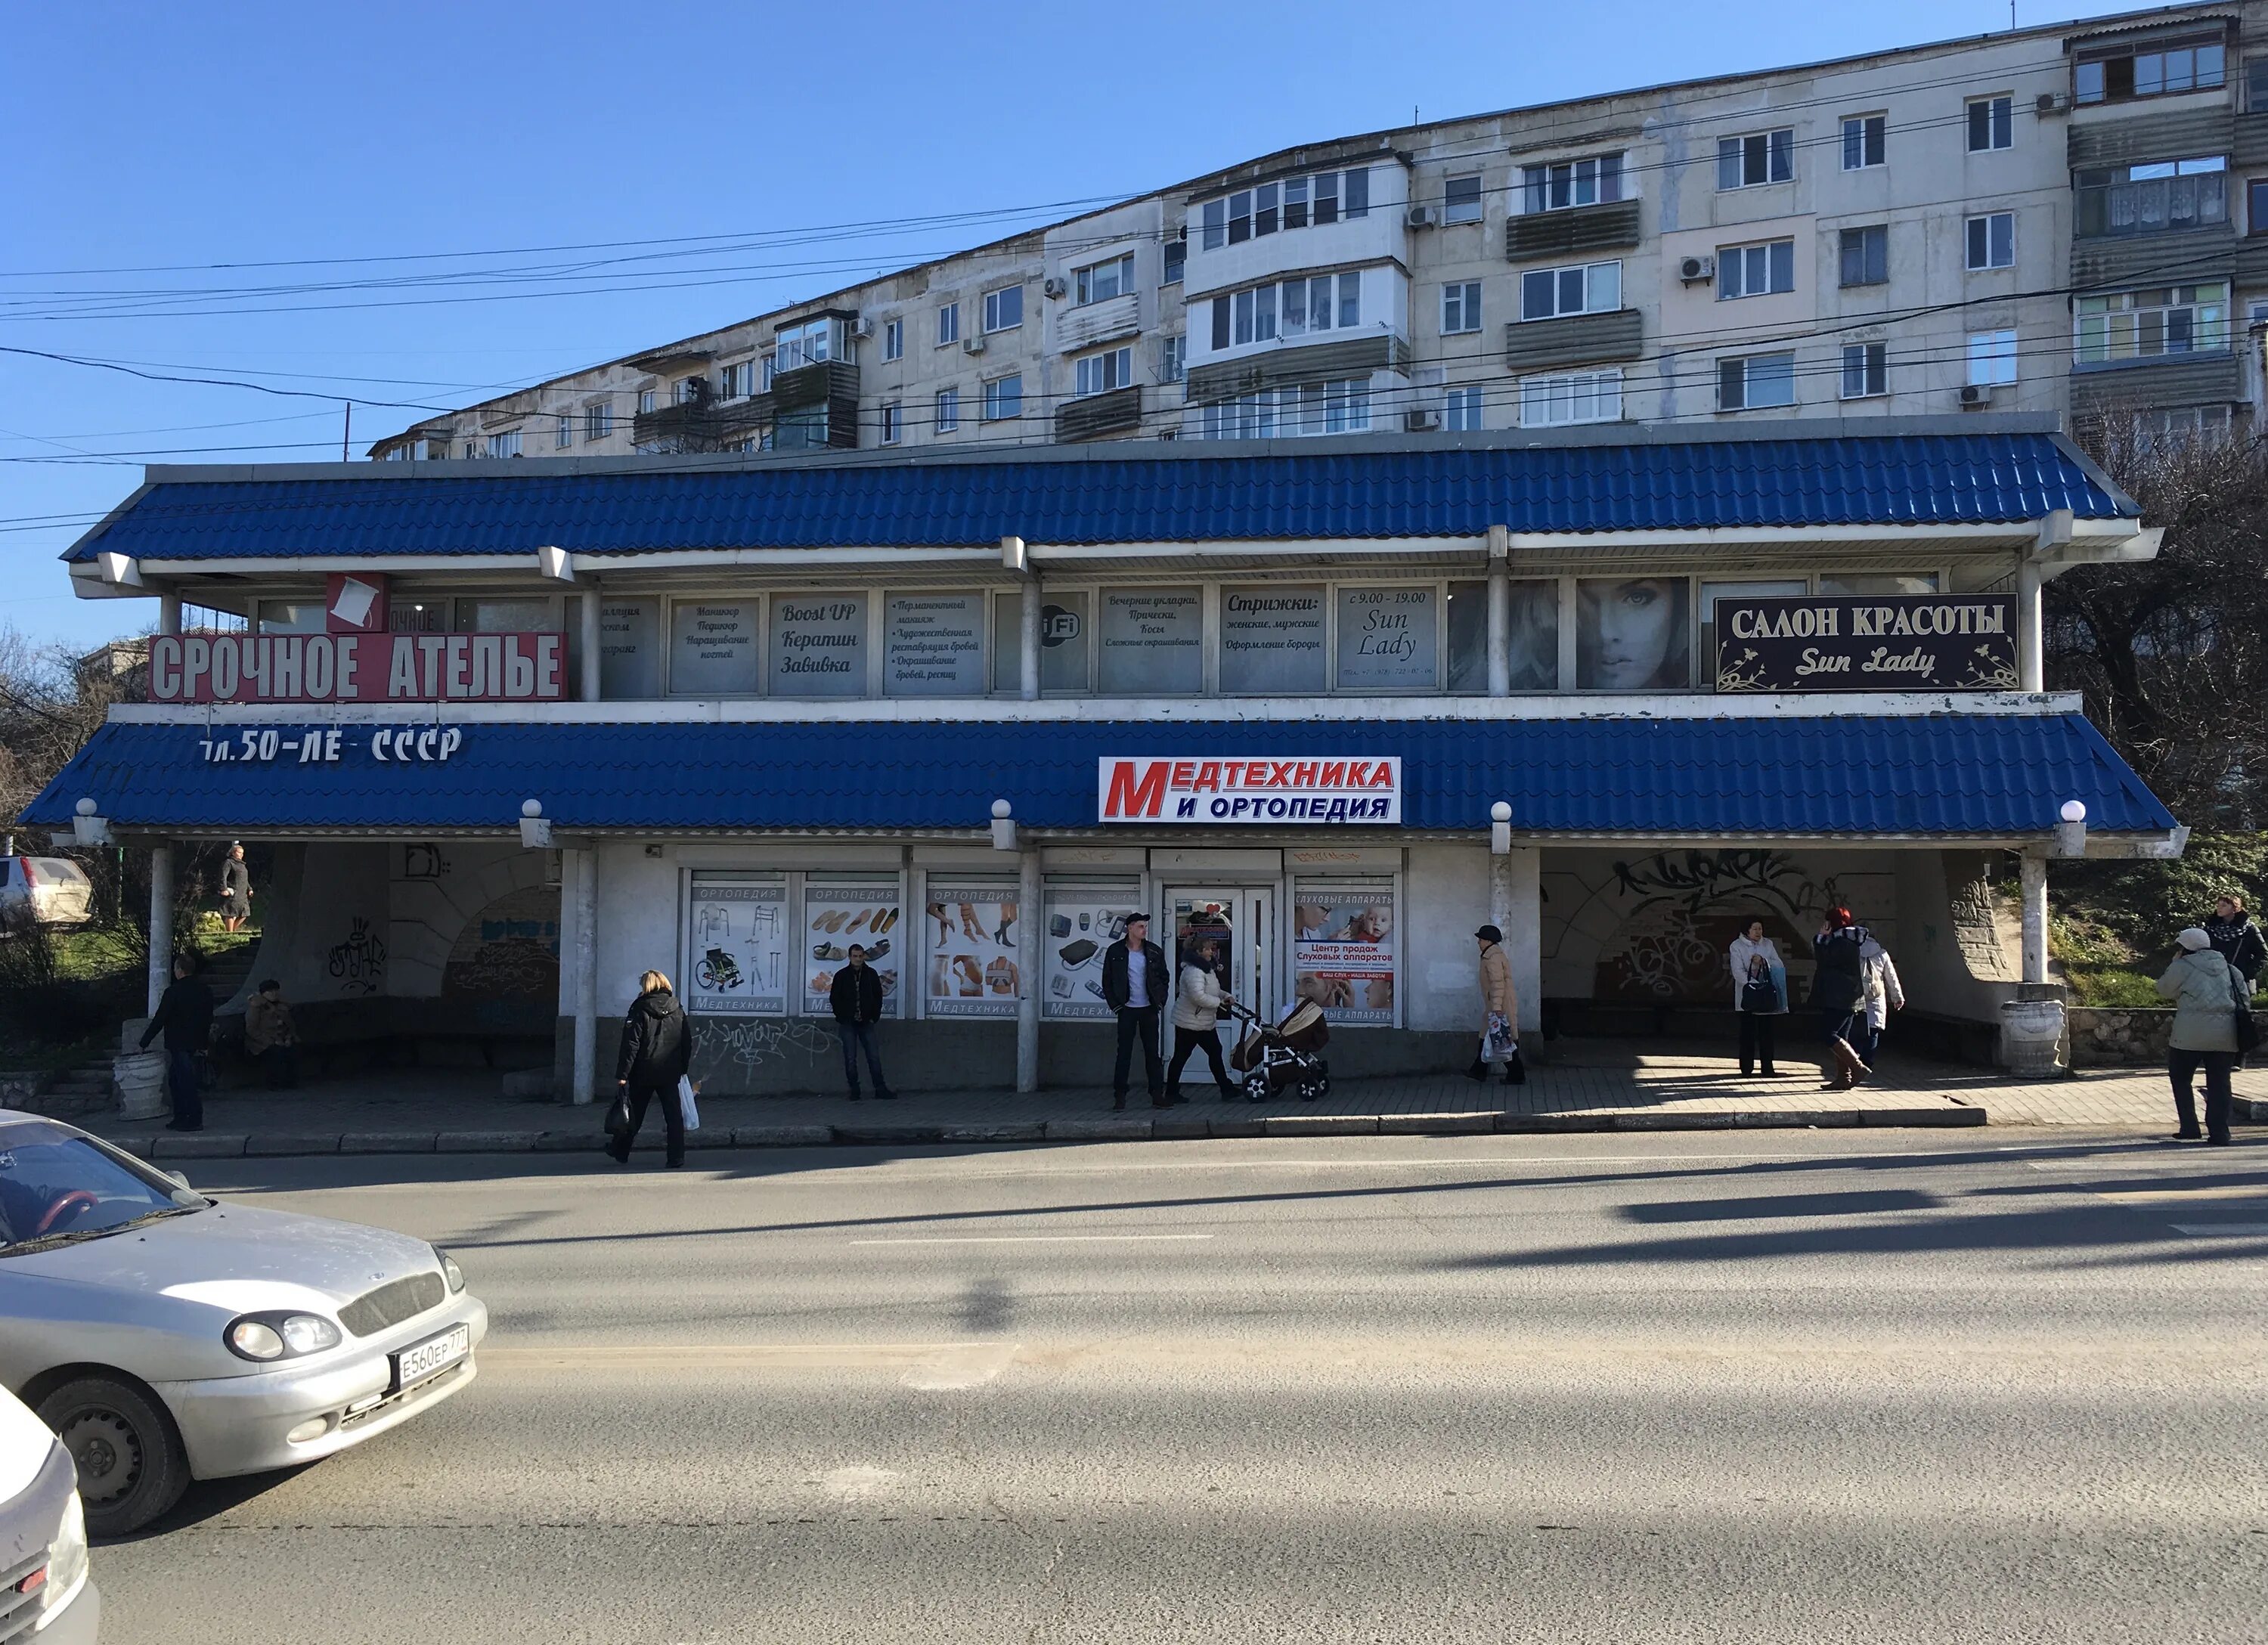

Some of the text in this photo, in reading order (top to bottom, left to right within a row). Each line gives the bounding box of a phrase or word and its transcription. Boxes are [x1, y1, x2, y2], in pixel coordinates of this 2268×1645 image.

[1108, 595, 1151, 607] Вечерние
[1359, 593, 1383, 604] 9.00
[1395, 593, 1427, 603] 19.00
[897, 599, 966, 612] Перманентный
[1228, 595, 1318, 615] Стрижки:
[696, 607, 740, 618] Маникюр
[782, 604, 856, 621] Boost UP
[1272, 620, 1320, 630] мужские
[1363, 609, 1408, 631] Sun
[1731, 605, 2006, 639] САЛОН КРАСОТЫ
[697, 621, 738, 633] Педикюр
[1140, 624, 1165, 634] Косы
[897, 627, 973, 640] Художественная
[685, 635, 750, 647] Наращивание
[782, 630, 859, 652] Кератин
[950, 641, 979, 653] бровей
[1105, 638, 1143, 647] Сложные
[1225, 640, 1320, 651] Оформление бороды
[1357, 630, 1418, 661] Lady
[700, 649, 734, 660] ногтей
[151, 634, 561, 700] СРОЧНОЕ АТЕЛЬЕ
[780, 655, 852, 674] Завивка
[897, 655, 957, 667] Окрашивание
[1795, 646, 1937, 678] Sun Lady
[927, 671, 957, 681] ресниц
[371, 727, 463, 761] СССР
[1176, 797, 1391, 822] И ОРТОПЕДИЯ
[700, 889, 777, 899] ОРТОПЕДИЯ
[815, 891, 894, 900] ОРТОПЕДИЯ
[934, 891, 1014, 901] ОРТОПЕДИЯ
[1296, 895, 1342, 904] СЛУХОВЫЕ
[1312, 943, 1378, 953] Центр продаж
[1297, 952, 1393, 962] Слуховых аппаратов
[696, 997, 778, 1011] МЕДТЕХНИКА
[930, 999, 1016, 1014] МЕДТЕХНИКА
